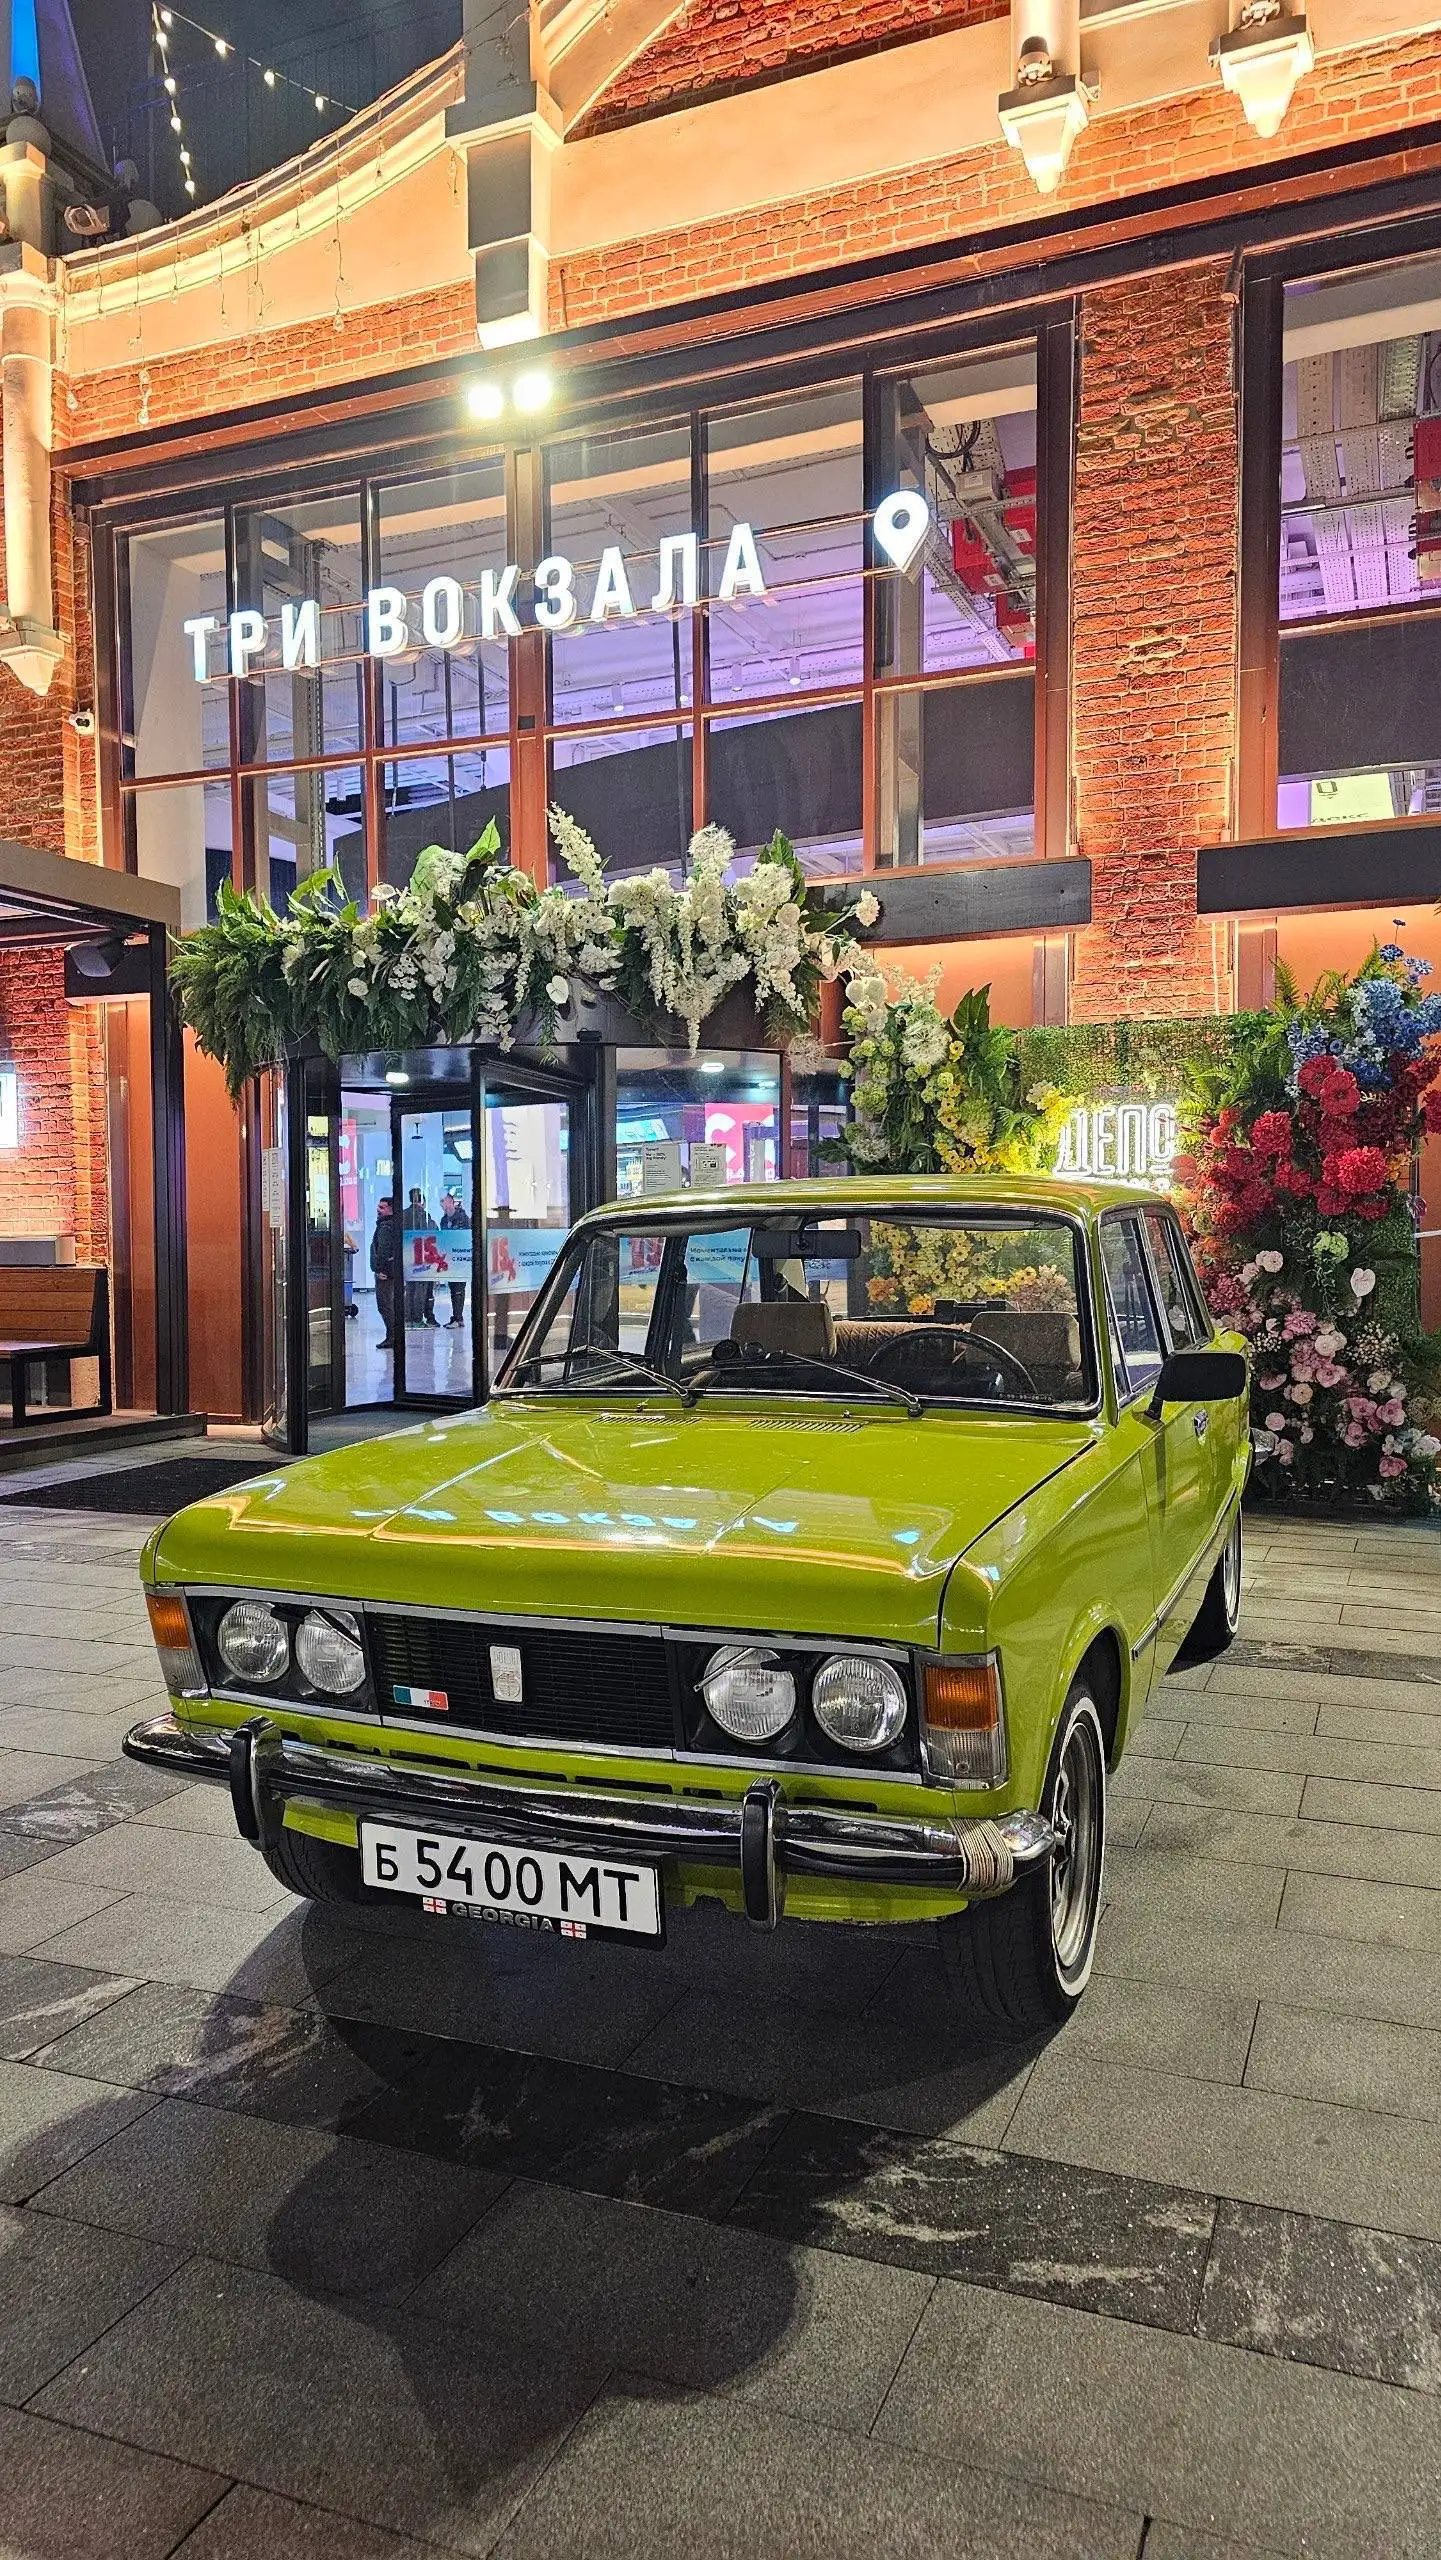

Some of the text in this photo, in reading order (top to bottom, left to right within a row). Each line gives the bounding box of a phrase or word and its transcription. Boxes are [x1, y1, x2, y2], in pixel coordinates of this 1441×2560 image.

[184, 522, 768, 683] ТРИ ВОКЗАЛА
[375, 1838, 640, 1922] Б 5400 МТ
[452, 1902, 556, 1932] GEORGIA
